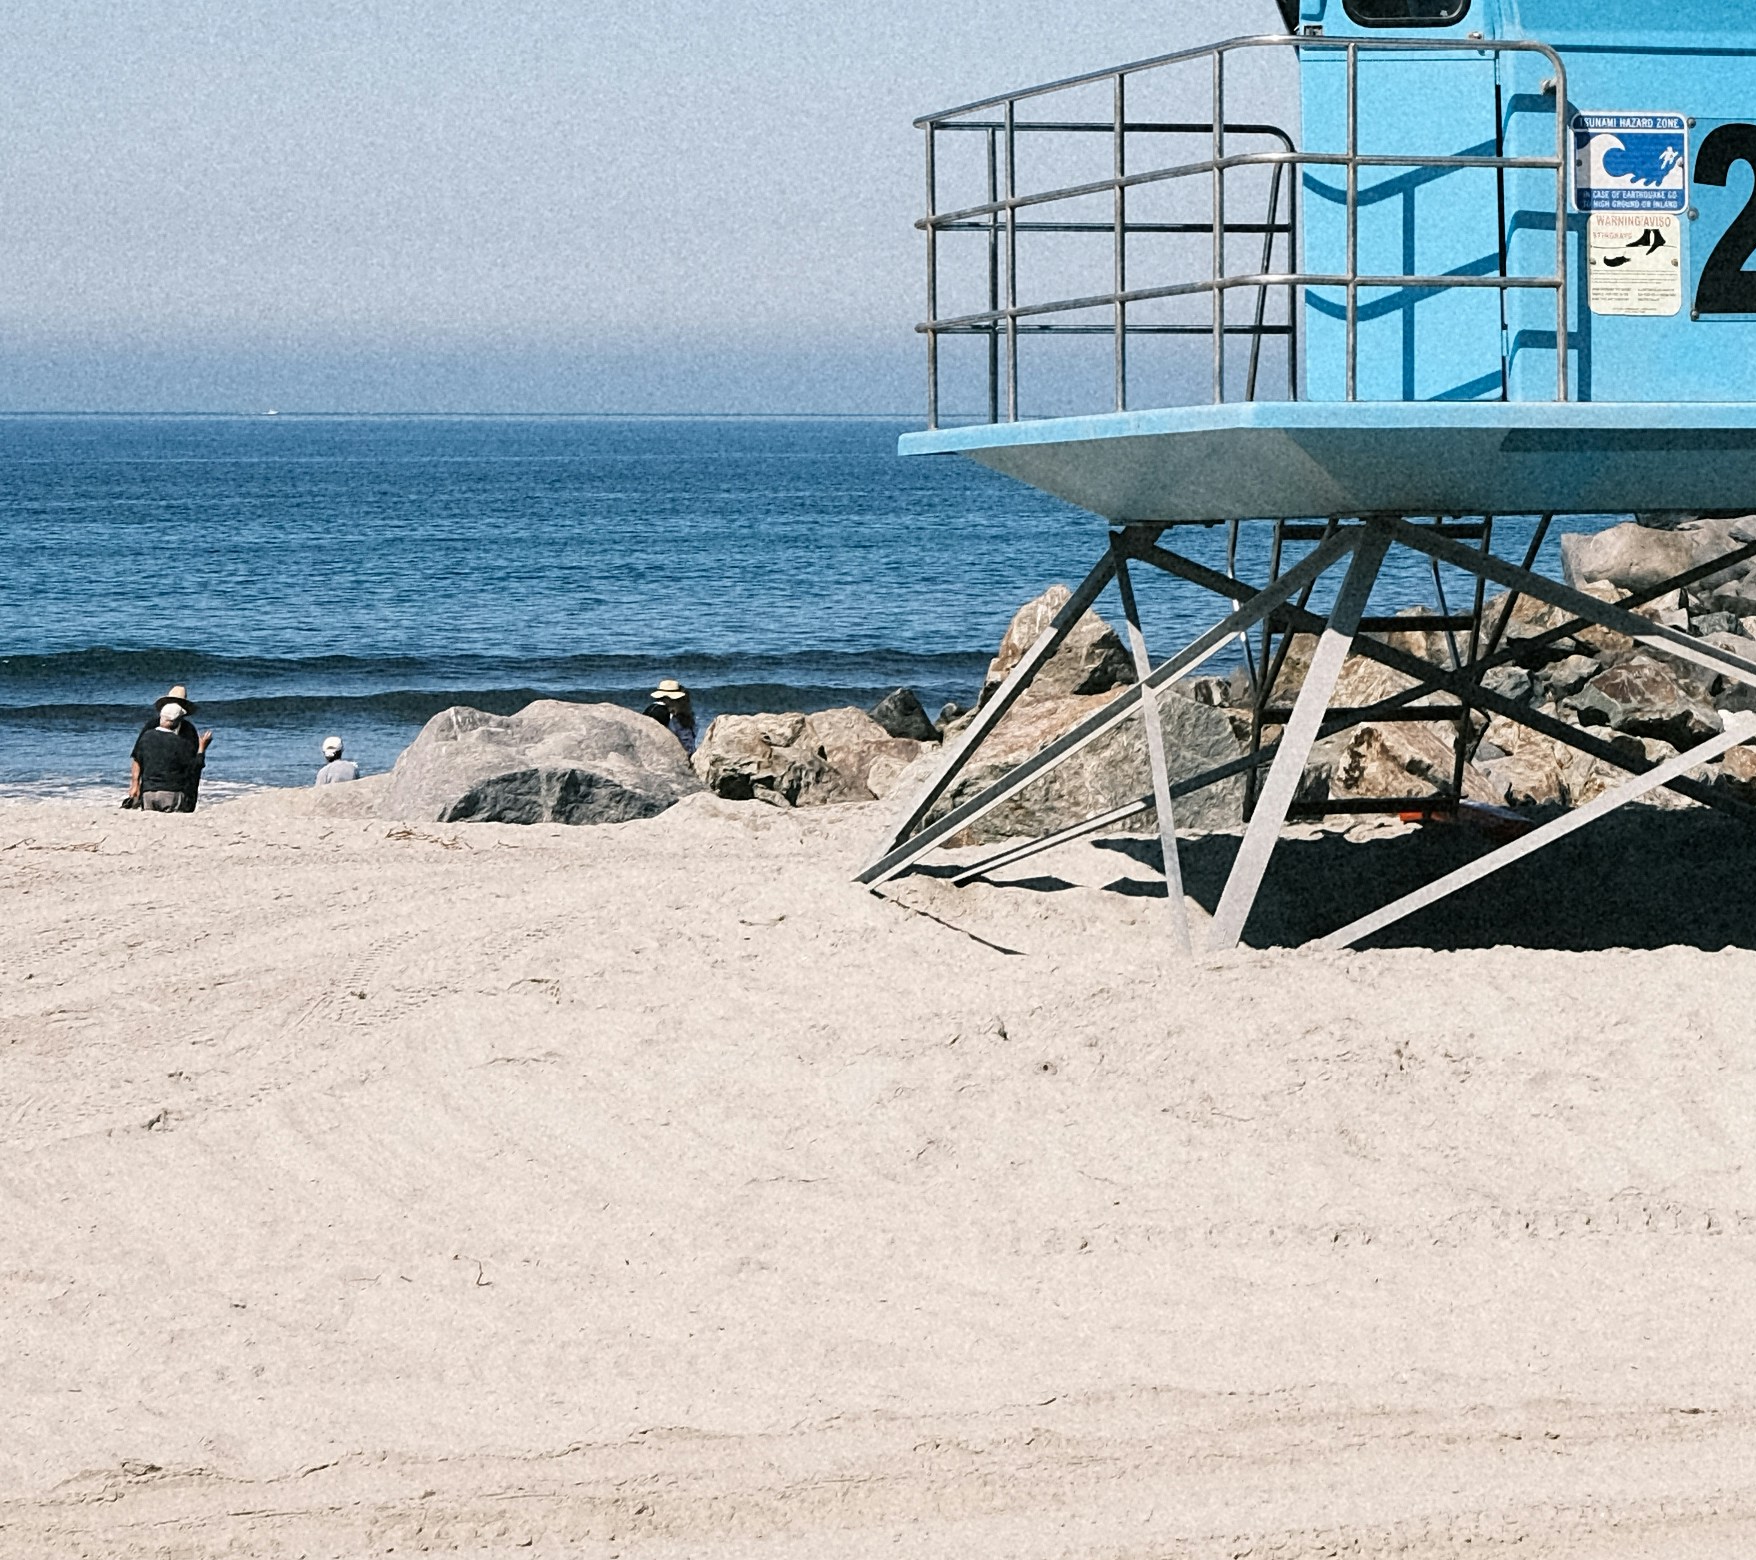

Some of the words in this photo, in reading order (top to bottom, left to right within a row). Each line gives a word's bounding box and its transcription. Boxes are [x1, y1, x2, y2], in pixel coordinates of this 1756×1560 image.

[1580, 117, 1616, 129] TSUNAMI
[1619, 117, 1653, 129] HAZARD
[1656, 118, 1680, 129] ZONE
[1592, 190, 1609, 199] CASE
[1611, 190, 1620, 199] OF
[1622, 190, 1665, 199] EARTHQUAKE
[1667, 190, 1678, 199] GO
[1593, 199, 1610, 208] HIGH
[1611, 199, 1640, 209] GROUND
[1641, 200, 1651, 209] OR
[1653, 199, 1678, 209] INLAND
